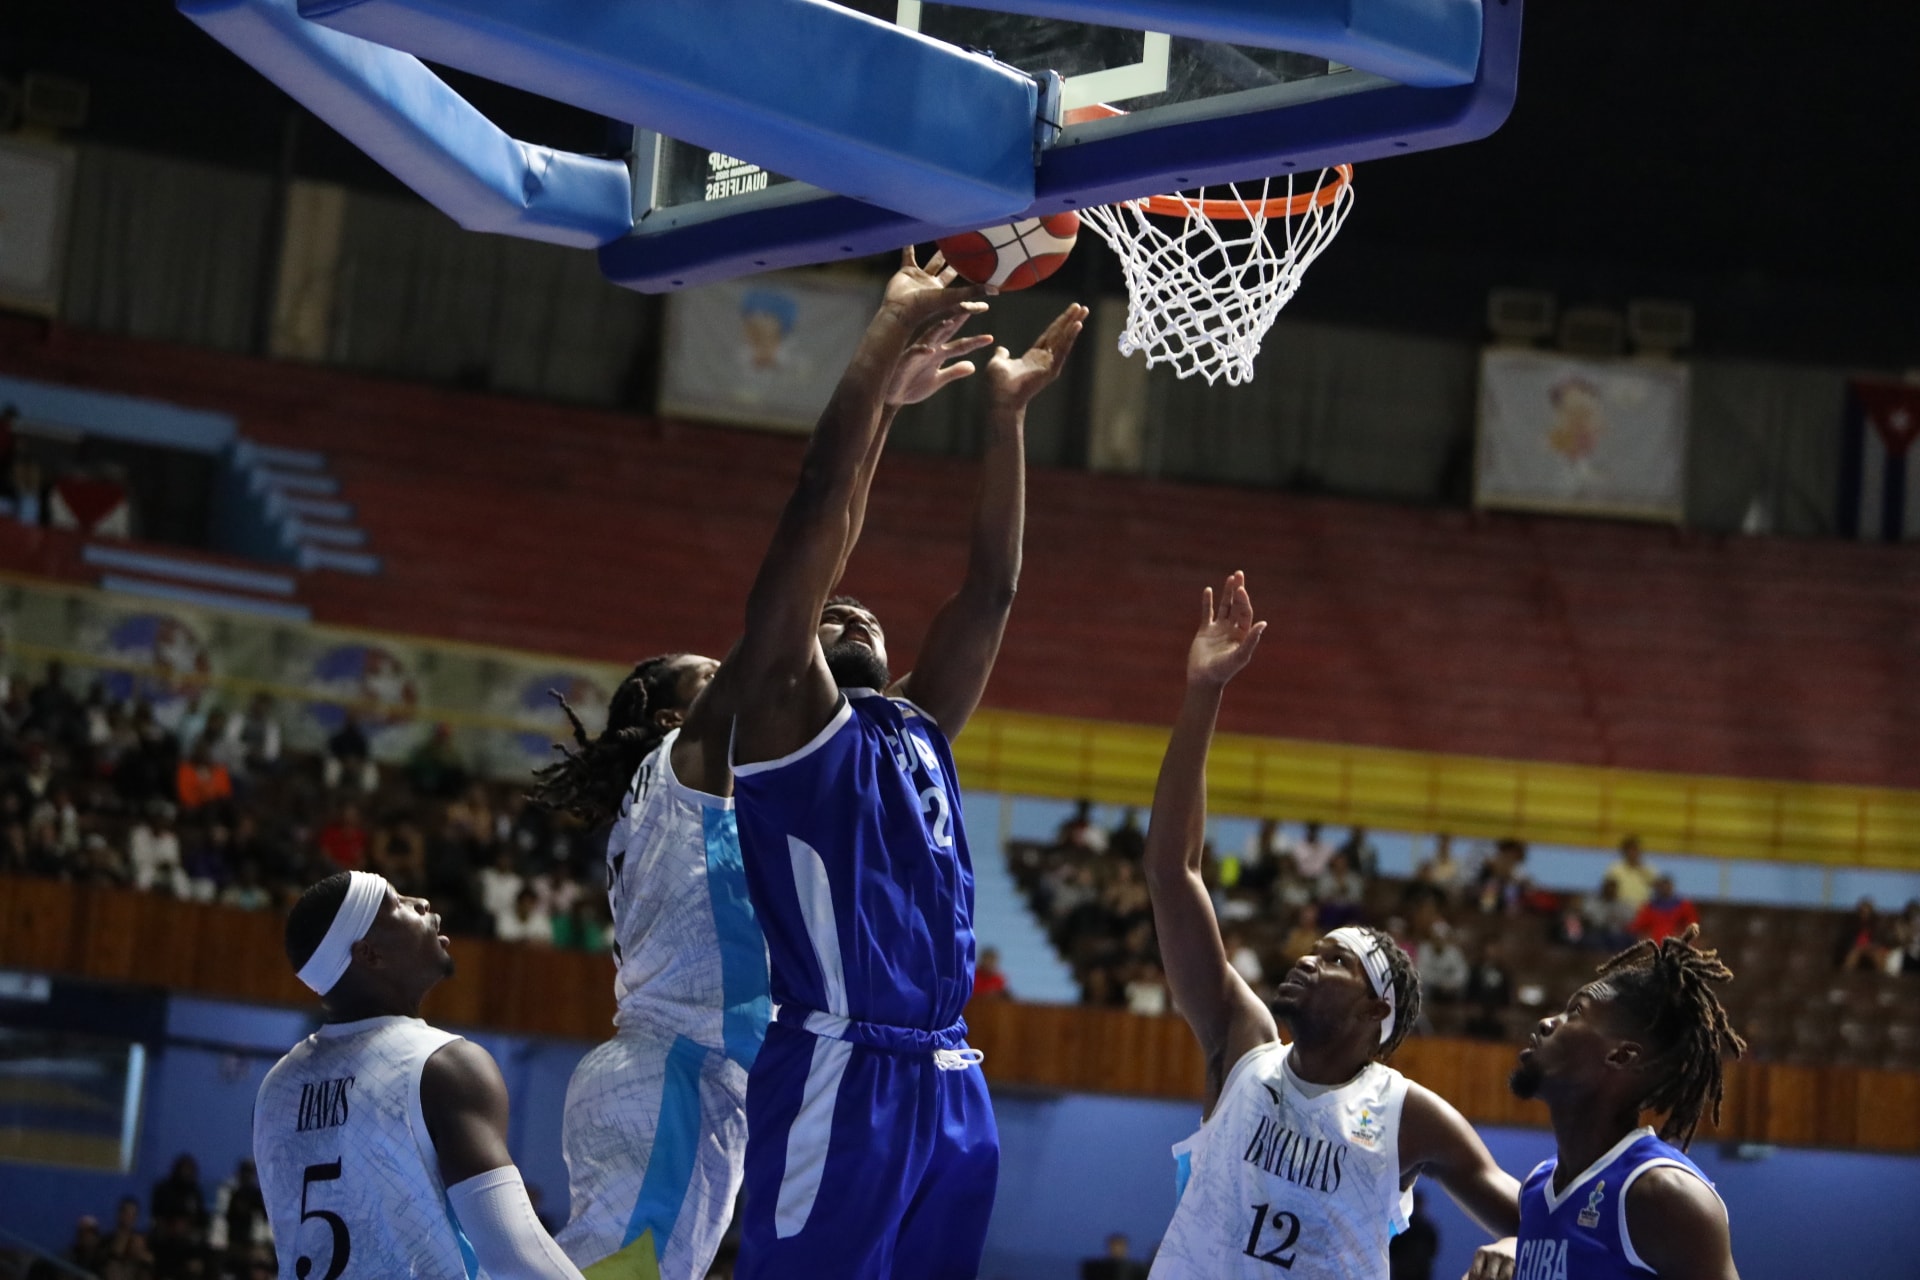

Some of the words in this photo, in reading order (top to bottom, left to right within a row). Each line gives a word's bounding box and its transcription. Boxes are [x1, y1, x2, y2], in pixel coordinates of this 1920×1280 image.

[919, 786, 953, 848] 2
[296, 1076, 356, 1132] DAVIS
[1243, 1114, 1348, 1195] BAHAMAS
[296, 1155, 351, 1280] 5
[1243, 1202, 1301, 1271] 12
[1517, 1238, 1569, 1280] CUBA
